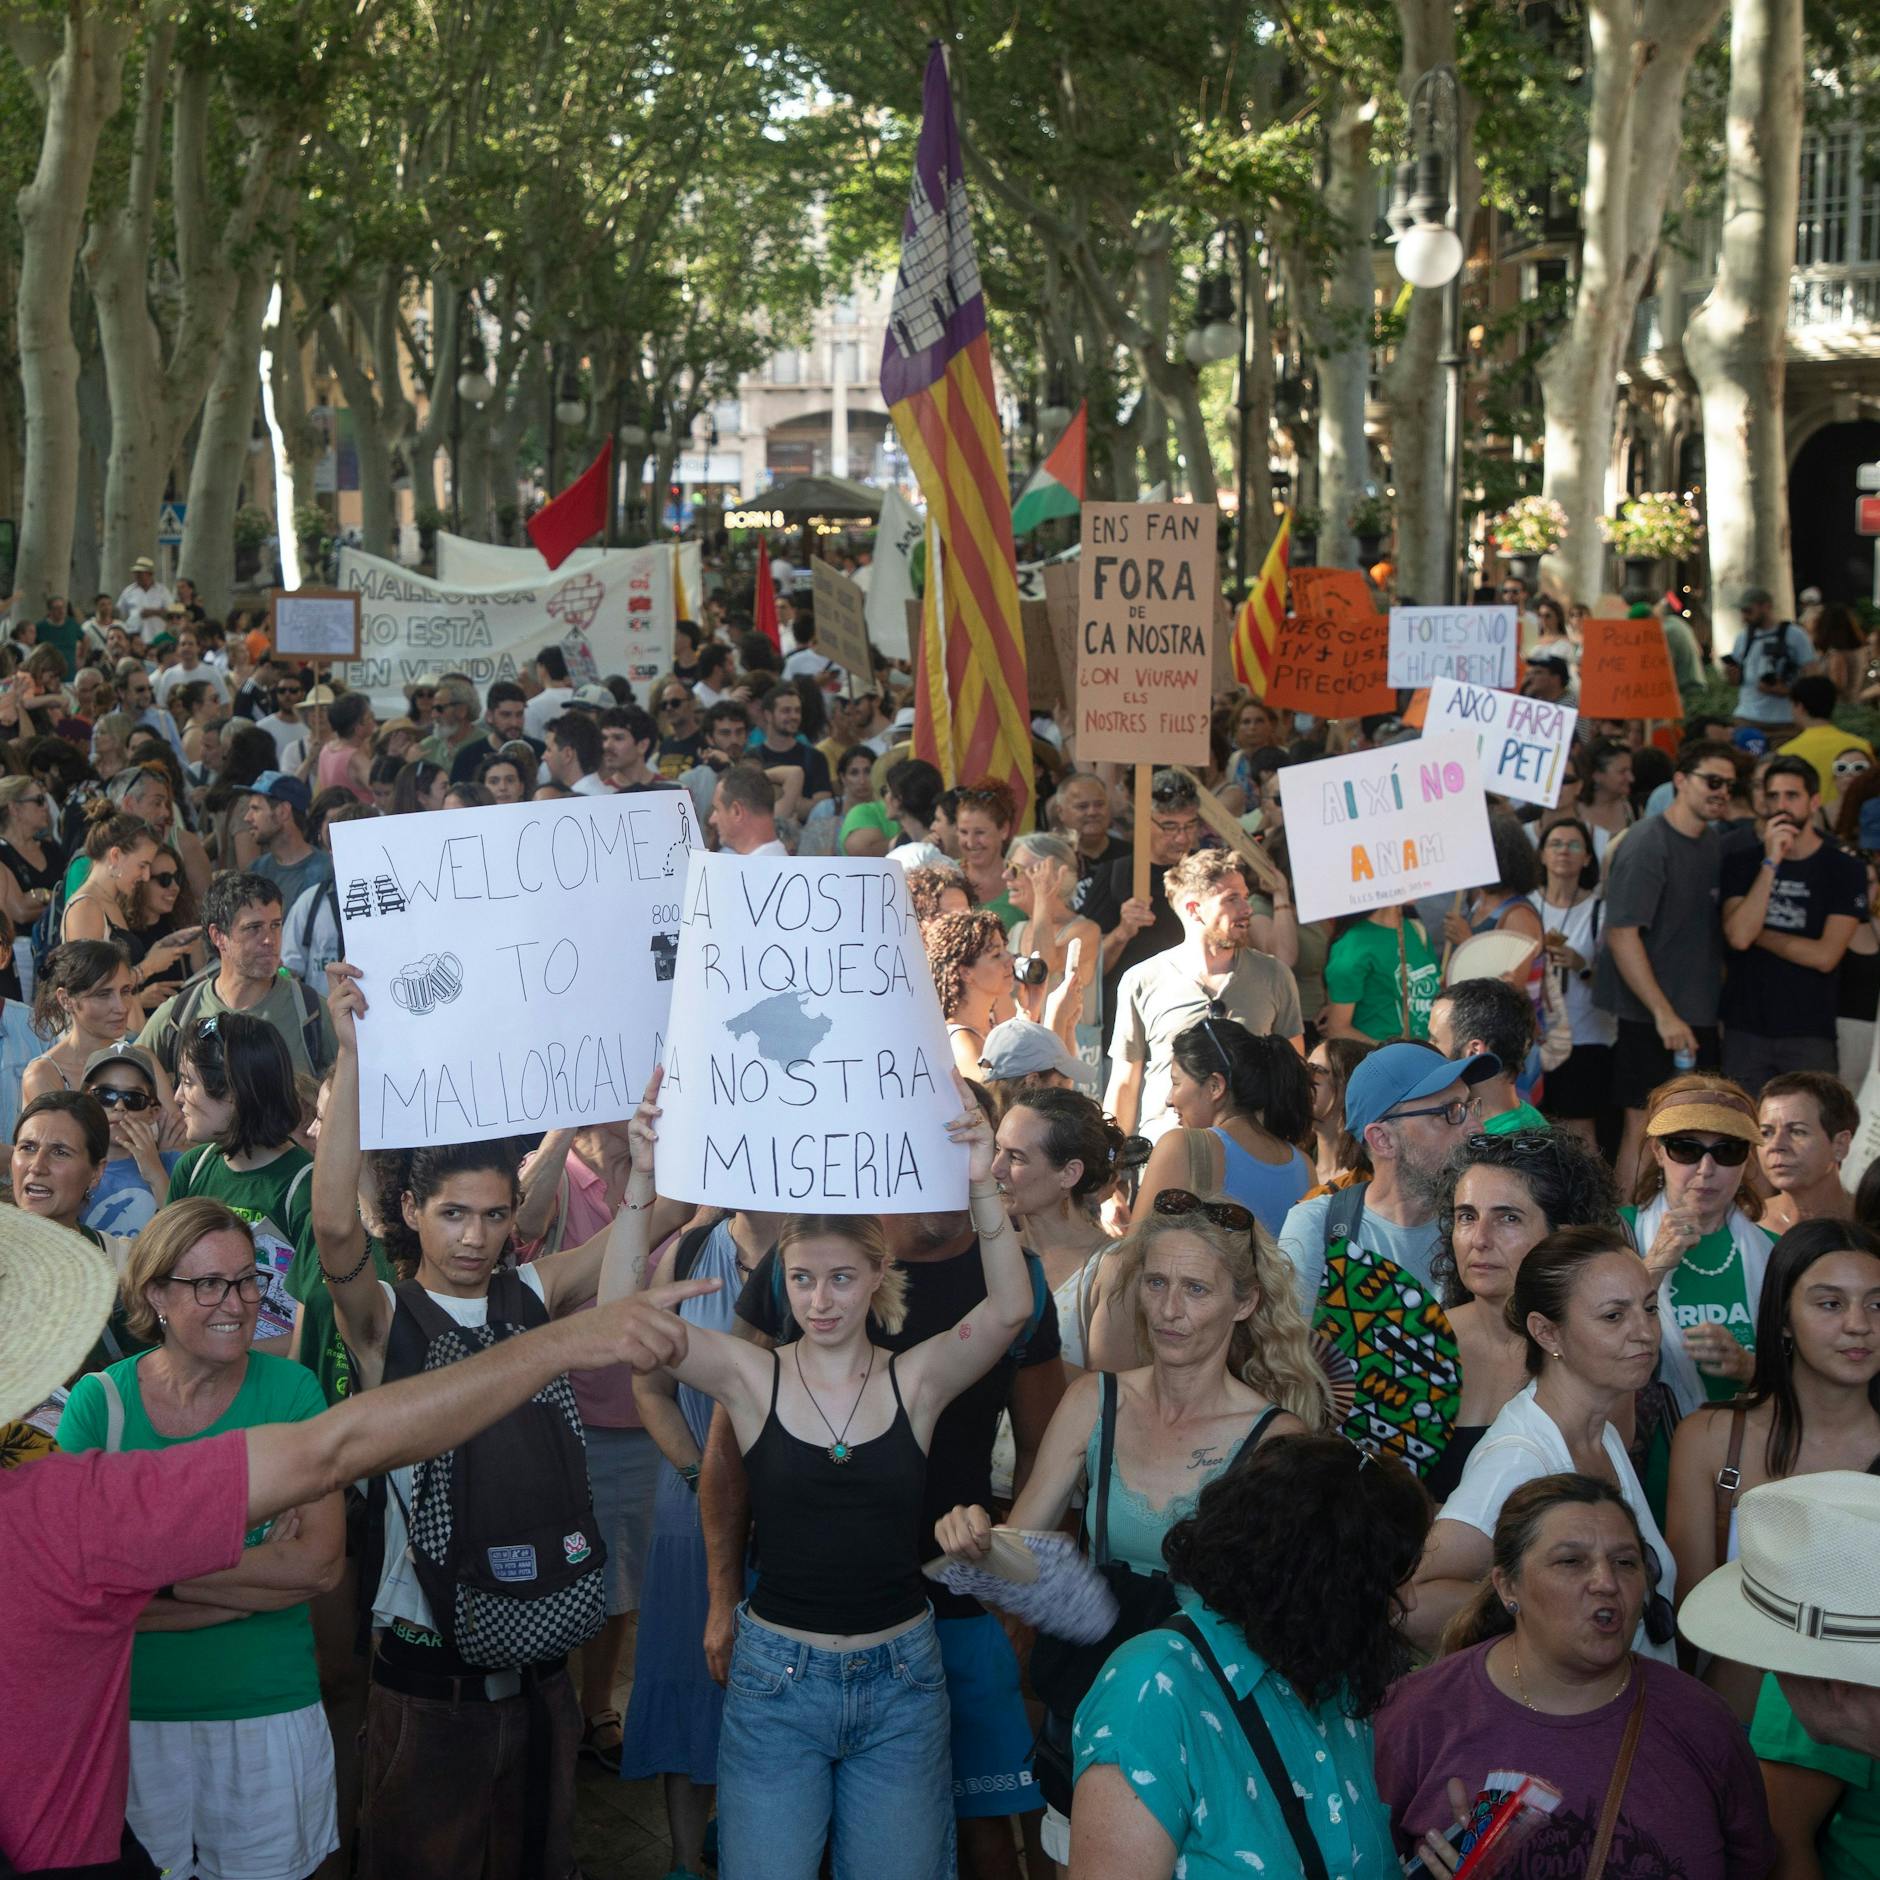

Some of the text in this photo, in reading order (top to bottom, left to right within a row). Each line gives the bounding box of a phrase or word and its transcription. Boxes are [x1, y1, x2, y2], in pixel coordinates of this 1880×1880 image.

[1092, 513, 1199, 544] ENS FAN
[1094, 556, 1195, 600] FORA
[407, 610, 493, 648] ESTÀ
[1129, 606, 1146, 619] DE
[1400, 613, 1508, 644] TOTES NO
[1085, 621, 1116, 655] CA
[1126, 623, 1205, 655] NOSTRA
[344, 657, 391, 687] EN
[1080, 667, 1119, 688] ¿ON
[1123, 692, 1148, 704] ELS
[1446, 685, 1565, 740] AIXÒ FARÀ
[1086, 709, 1147, 733] NOSTRES
[1322, 761, 1465, 825] AIXÍ NO
[381, 809, 661, 904] WELCOME
[1351, 833, 1445, 882] ANAM
[740, 870, 920, 936] VOSTRA
[495, 937, 580, 1002] TO
[701, 943, 915, 997] RIQUESA,
[711, 1045, 936, 1107] NOSTRA
[703, 1131, 923, 1200] MISERIA
[966, 1773, 1019, 1794] BOSS
